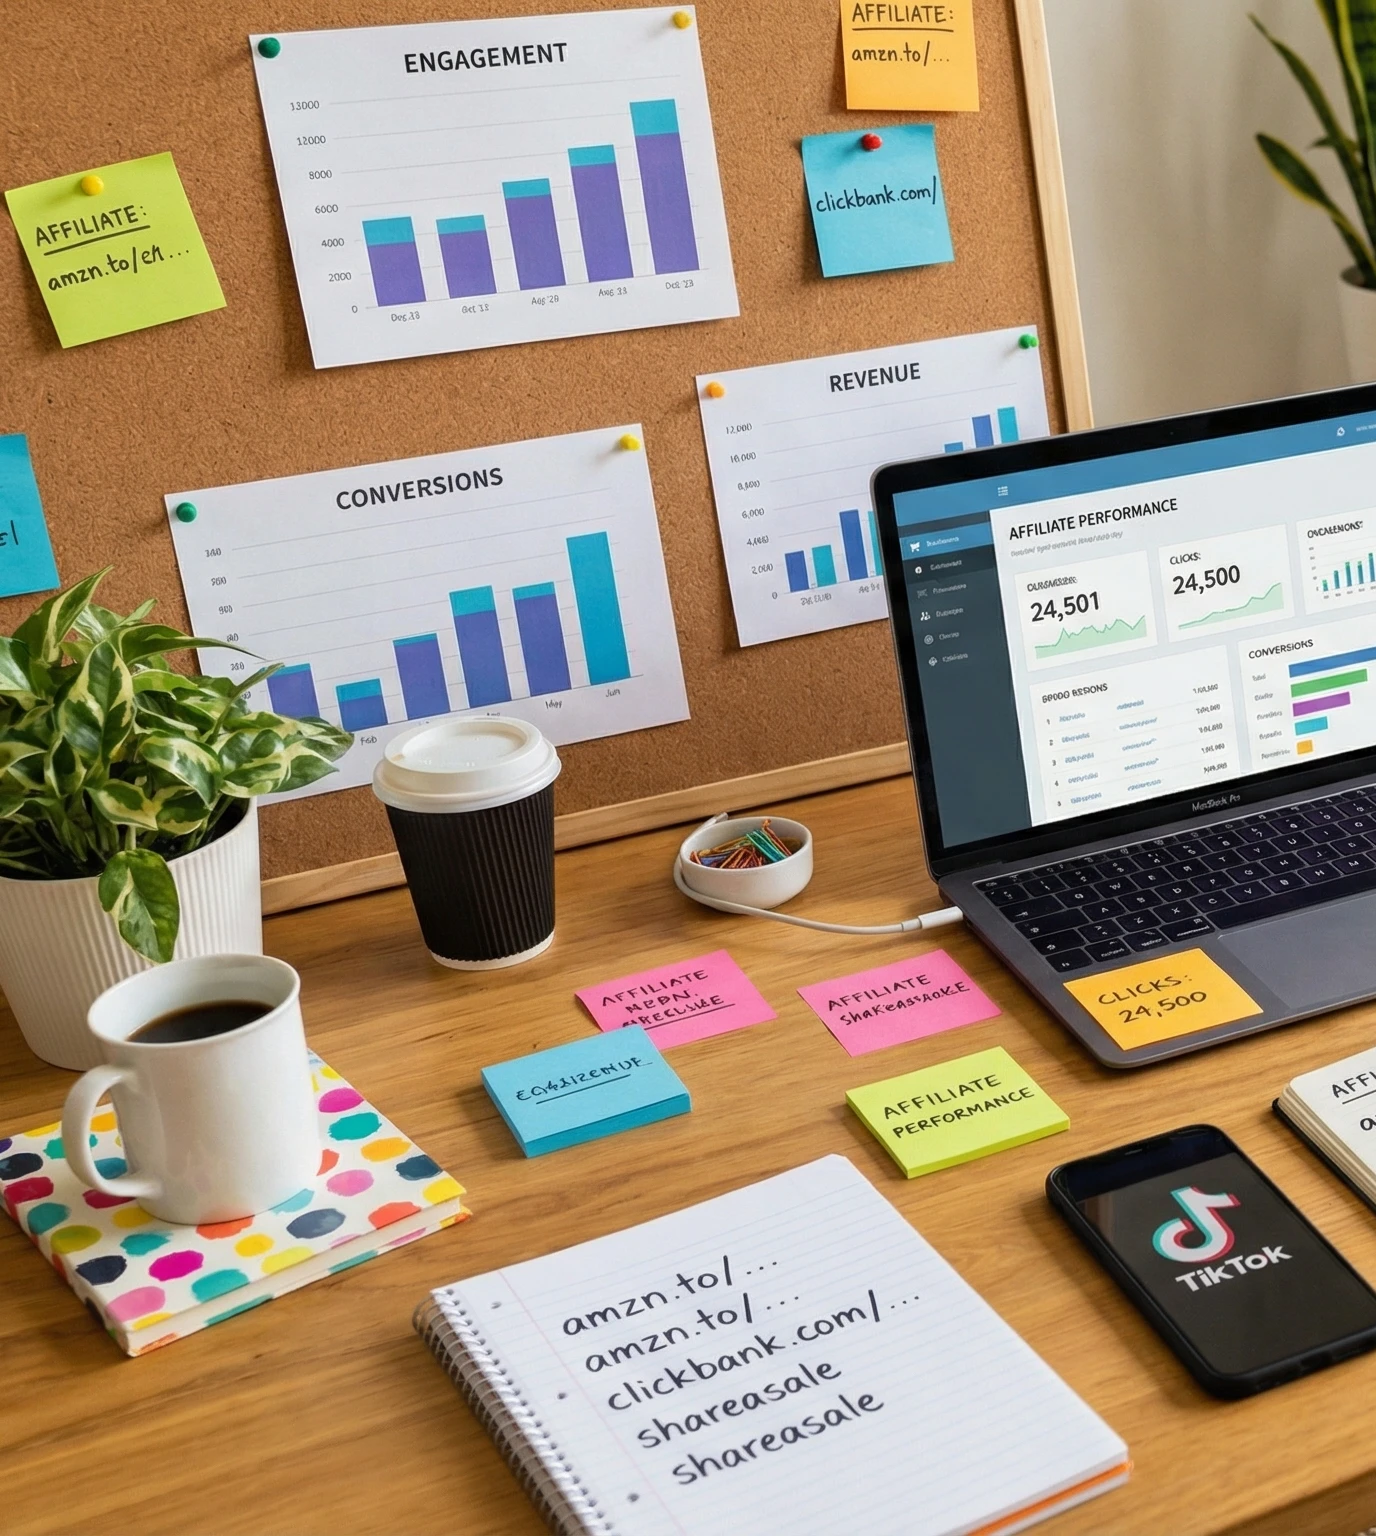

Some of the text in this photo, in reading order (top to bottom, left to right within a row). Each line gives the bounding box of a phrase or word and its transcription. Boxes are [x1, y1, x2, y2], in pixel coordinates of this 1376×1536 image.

[852, 2, 954, 23] AFFILIATE:
[403, 41, 568, 75] ENGAGEMENT
[816, 175, 937, 213] clickbank.com/
[35, 204, 148, 247] AFFILIATE:
[320, 237, 345, 248] 4000
[328, 271, 352, 282] 2000
[829, 362, 921, 393] REVENUE
[335, 466, 504, 512] CONVERSIONS
[1009, 498, 1178, 541] AFFILIATE PERFORMANCE
[1172, 564, 1241, 595] 24,500
[1030, 591, 1099, 622] 24,501
[602, 969, 709, 1006] AFFILIATE
[828, 974, 931, 1012] AFFILIATE
[1098, 974, 1193, 1005] CLICKS:
[1118, 991, 1207, 1024] 24,500
[882, 1072, 1002, 1121] AFFILIATE
[892, 1086, 1035, 1140] PERFORMANCE
[1174, 1245, 1293, 1293] TikTok
[637, 1361, 842, 1449] shareasale
[672, 1394, 885, 1486] shareasale
